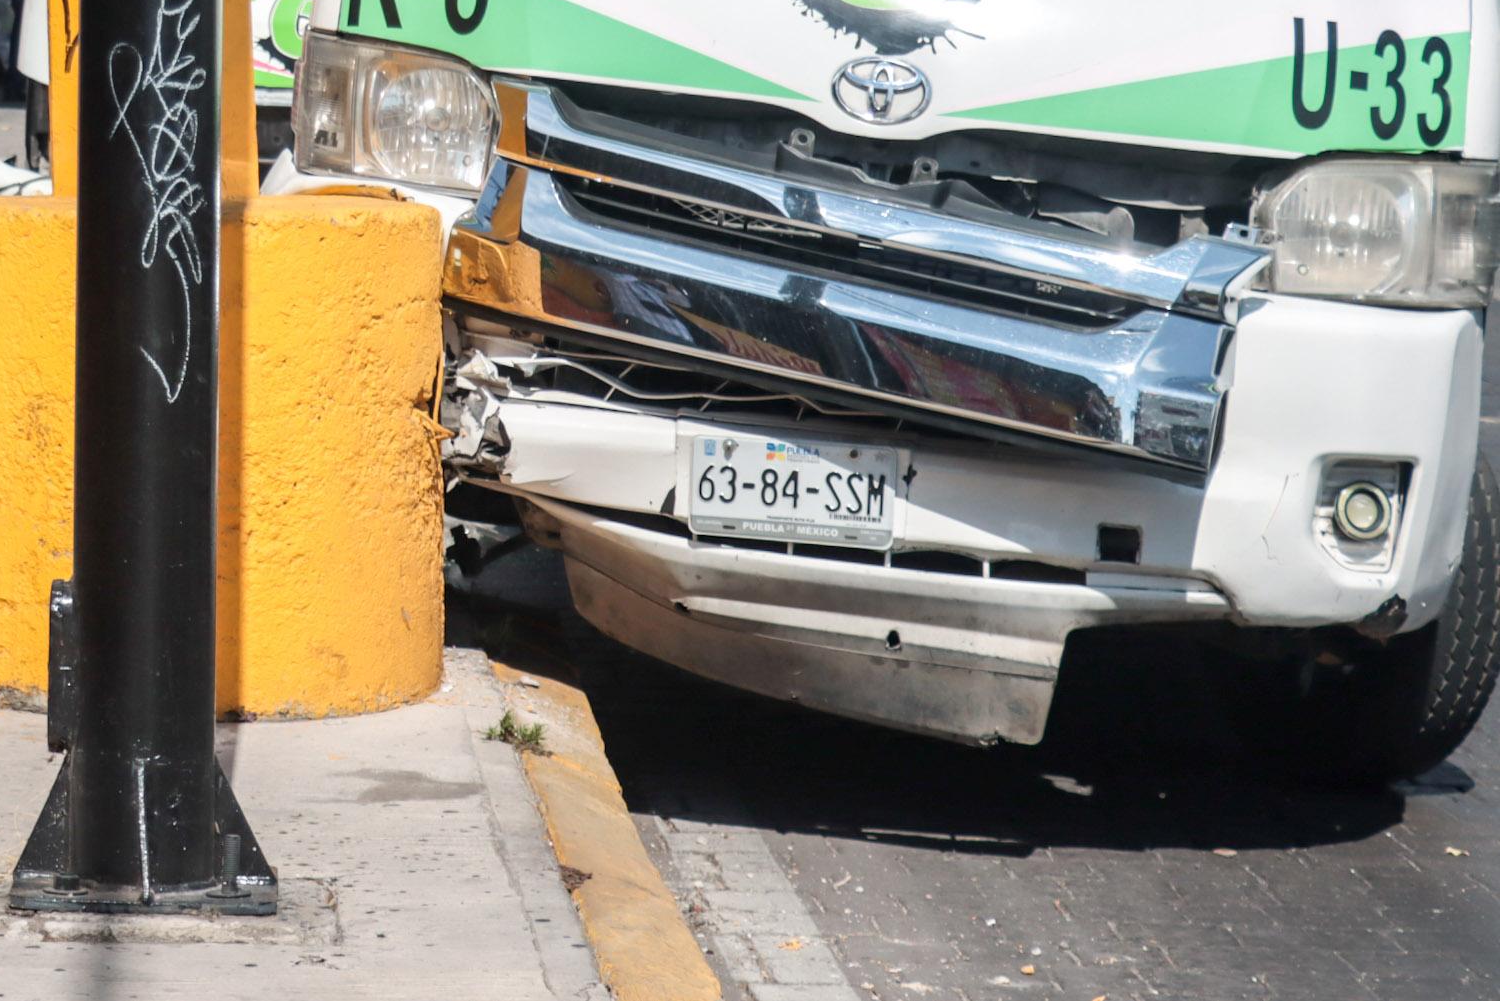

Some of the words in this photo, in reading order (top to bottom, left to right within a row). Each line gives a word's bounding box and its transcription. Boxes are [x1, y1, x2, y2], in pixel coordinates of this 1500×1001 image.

[1292, 16, 1451, 147] U-33
[699, 465, 886, 517] 63-84-SSM
[742, 521, 785, 533] PUEBLA
